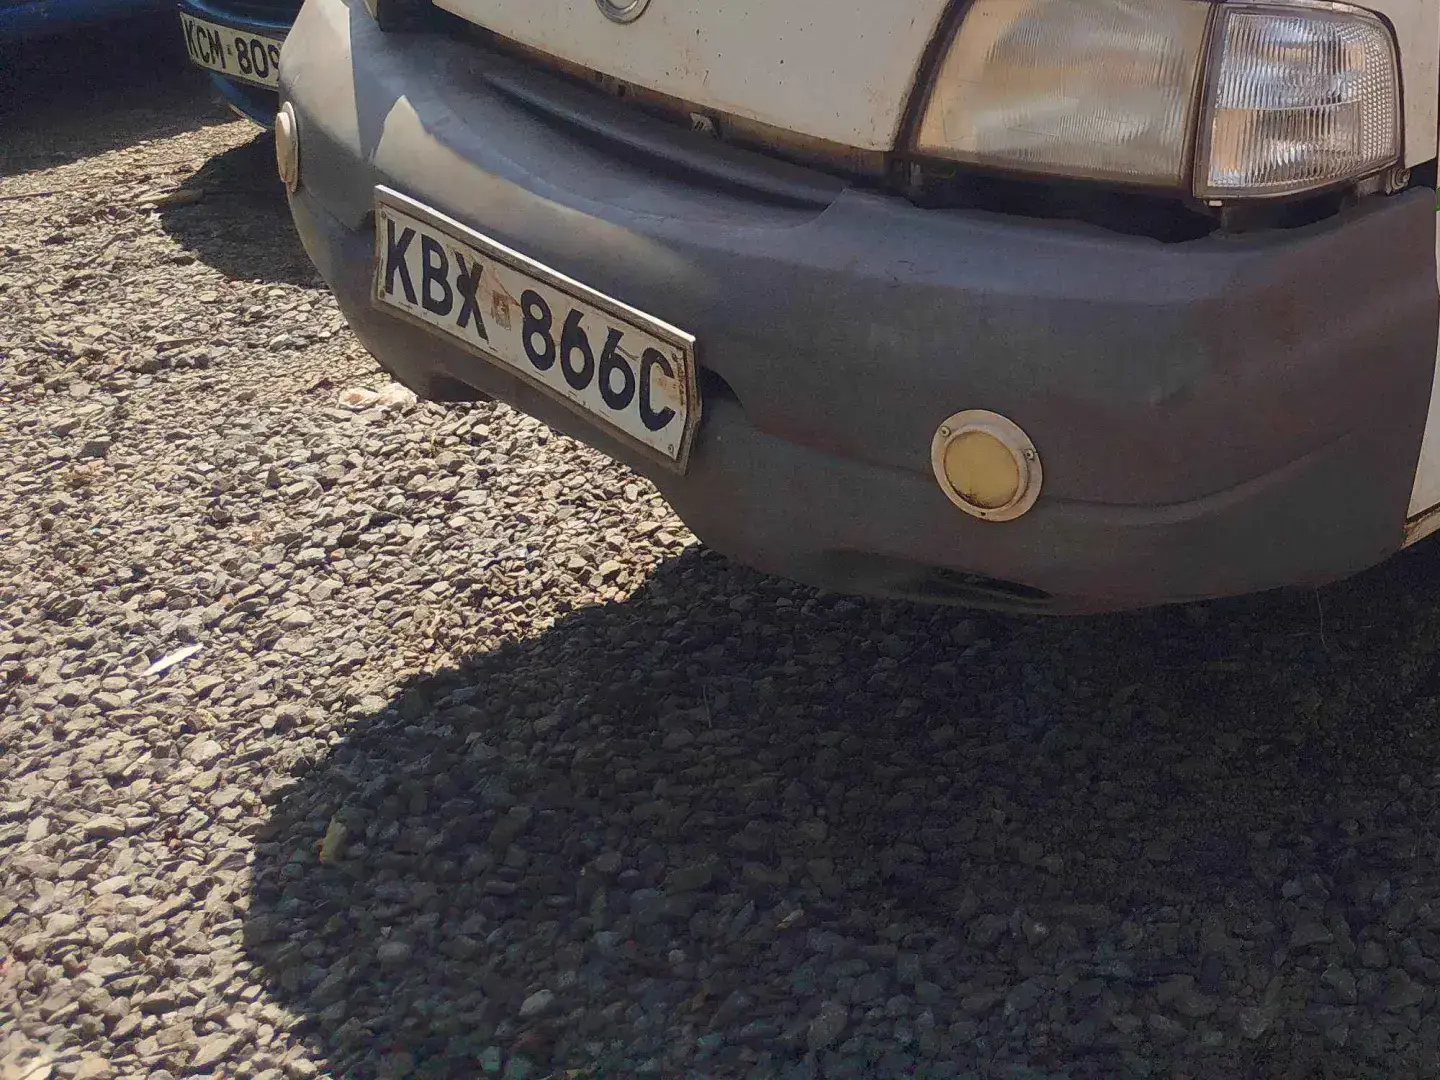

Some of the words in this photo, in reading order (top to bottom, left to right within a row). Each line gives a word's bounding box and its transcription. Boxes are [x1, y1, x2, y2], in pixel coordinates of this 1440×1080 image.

[184, 20, 227, 69] KCM
[385, 219, 489, 342] KBX
[520, 289, 677, 432] 866C
